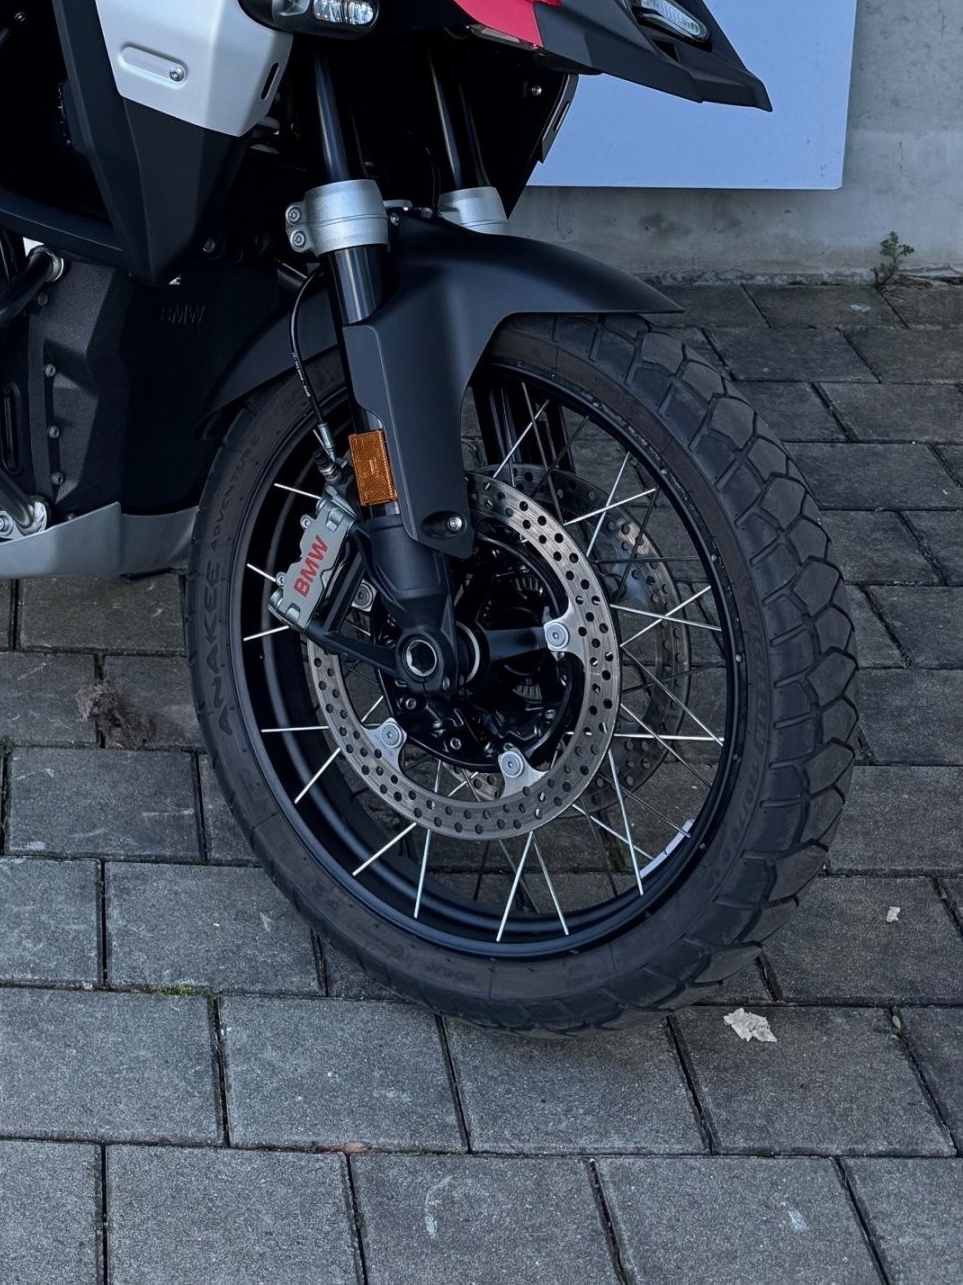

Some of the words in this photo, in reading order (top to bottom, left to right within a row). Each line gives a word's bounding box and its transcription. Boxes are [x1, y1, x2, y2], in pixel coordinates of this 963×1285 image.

[210, 434, 259, 552] ADVENTURE
[293, 535, 328, 598] BMW
[203, 561, 233, 735] ANAKEE
